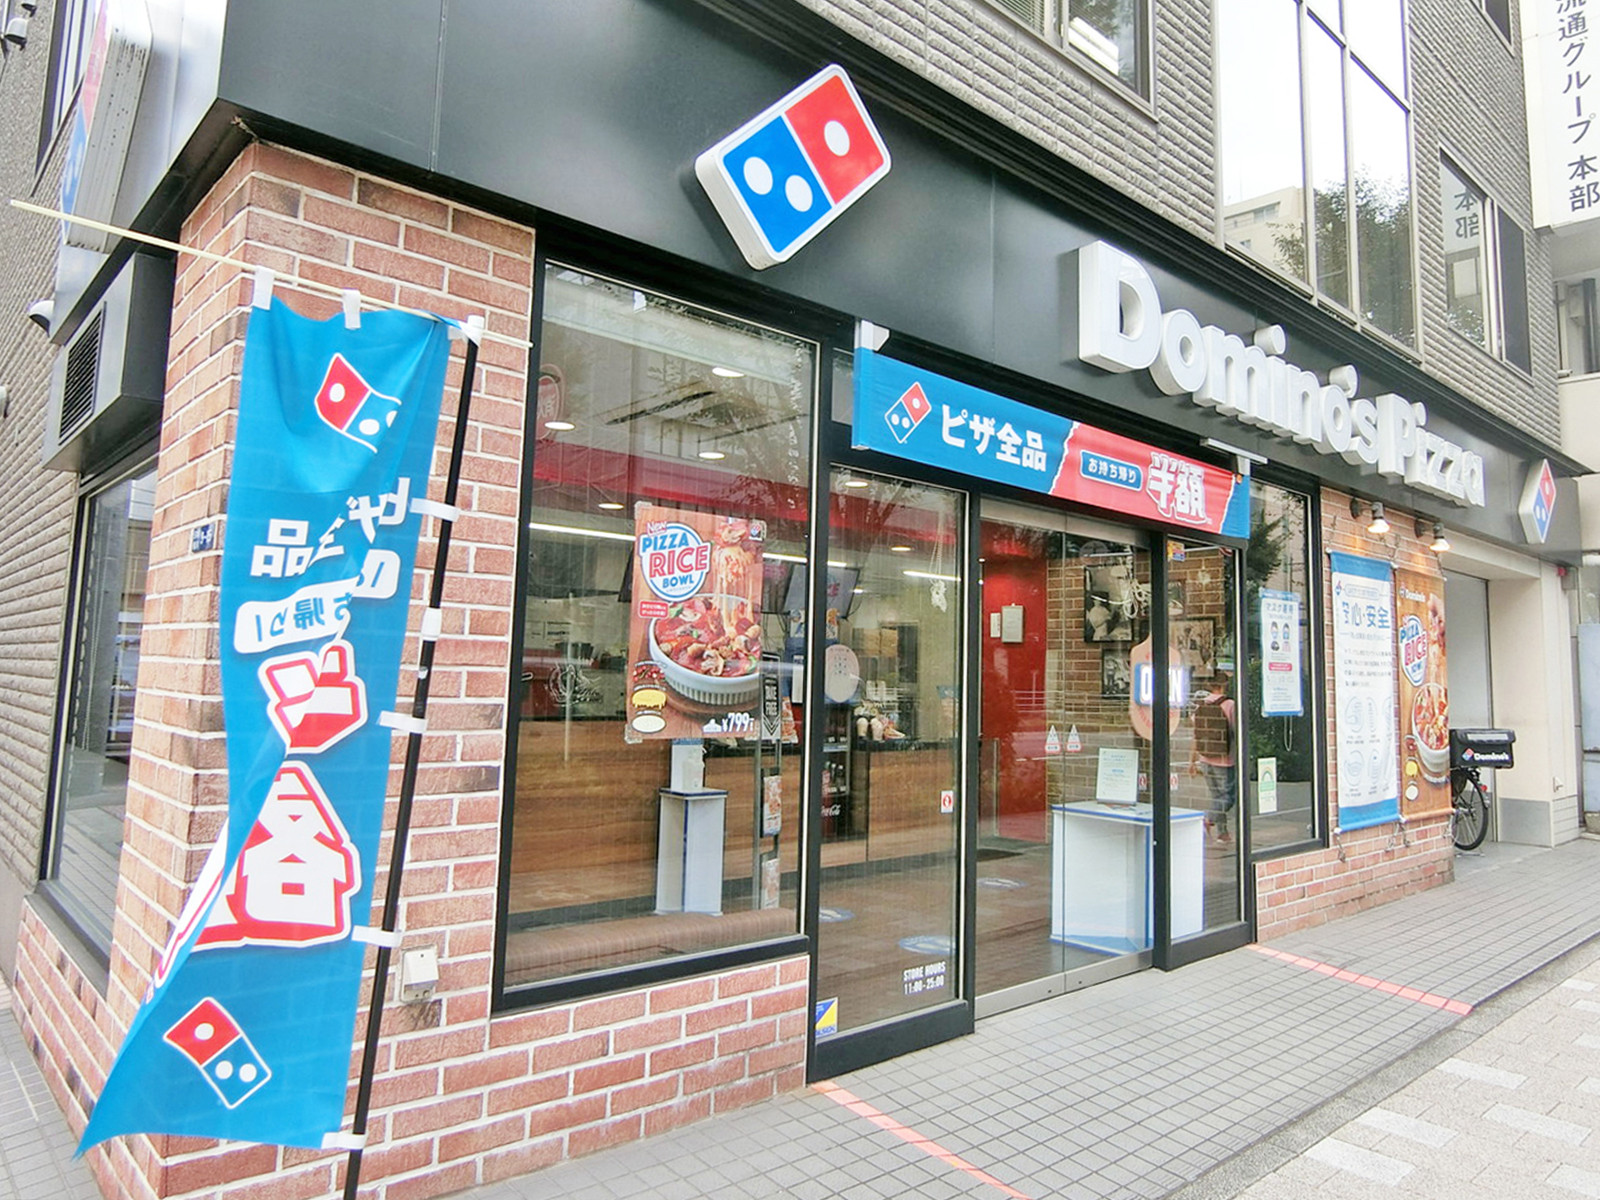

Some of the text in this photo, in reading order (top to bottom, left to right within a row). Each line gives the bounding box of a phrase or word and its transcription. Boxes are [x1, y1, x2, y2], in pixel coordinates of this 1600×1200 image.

[1079, 240, 1486, 508] Domino's Pizza
[942, 404, 1047, 472] ピザ全品
[1088, 457, 1137, 484] お持ち帰り
[1148, 452, 1206, 522] 半額
[642, 532, 689, 553] PIZZA
[649, 545, 709, 578] RICE
[662, 574, 695, 589] BOWL
[903, 961, 946, 981] STORE HOURS
